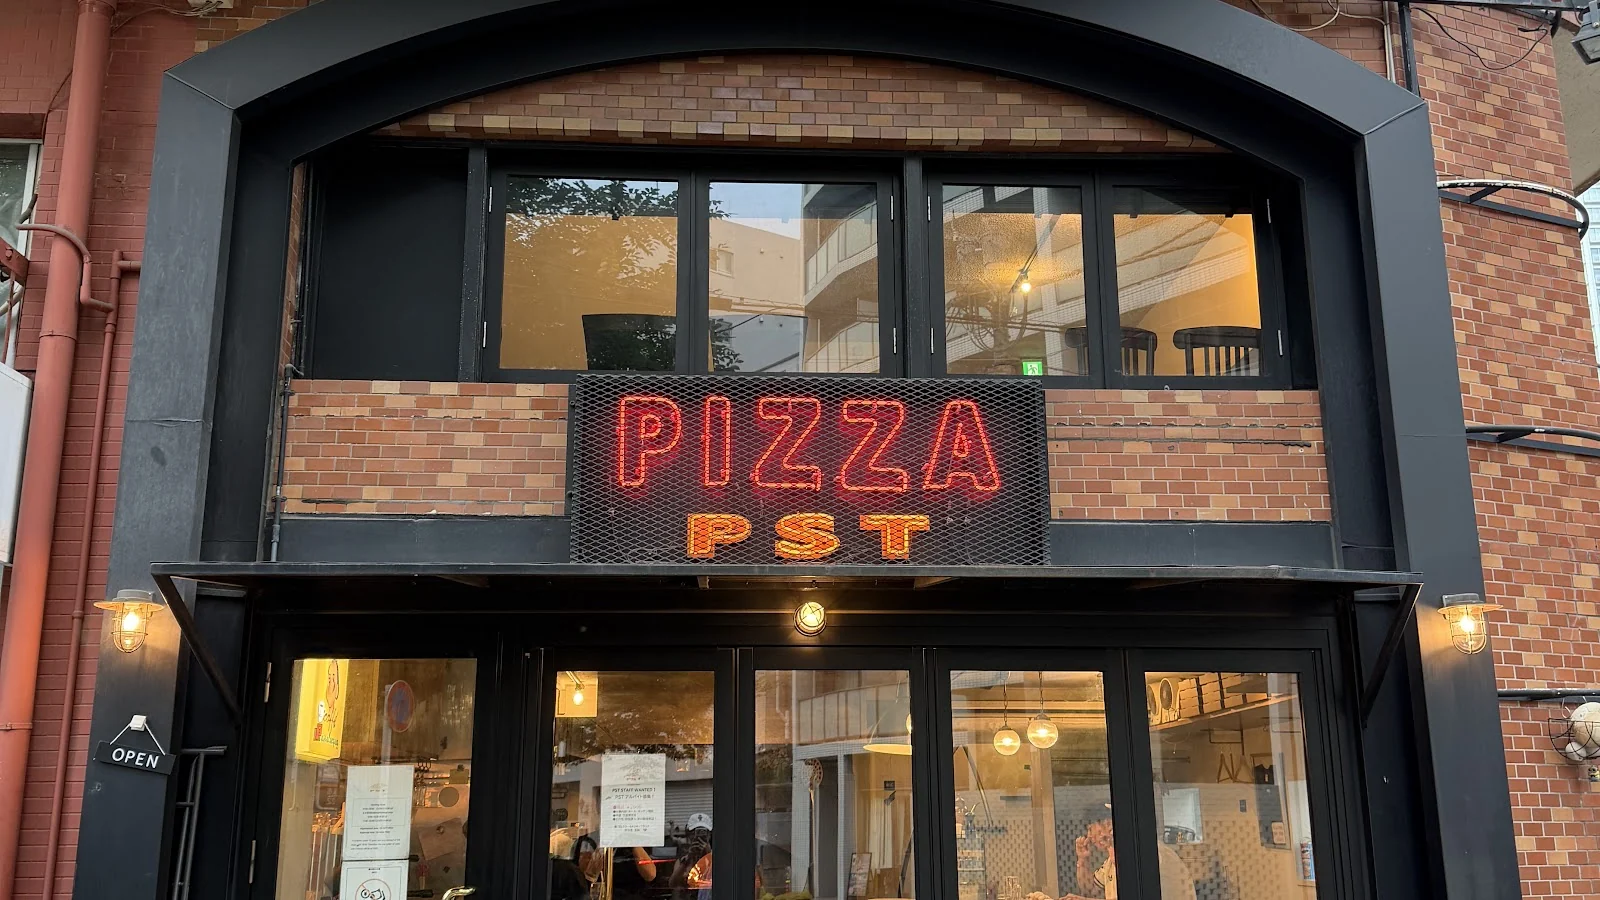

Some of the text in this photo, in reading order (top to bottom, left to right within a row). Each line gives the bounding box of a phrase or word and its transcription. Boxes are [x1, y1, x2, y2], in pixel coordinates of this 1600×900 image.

[618, 396, 1001, 493] PIZZA
[687, 512, 930, 560] PST
[112, 748, 160, 769] OPEN
